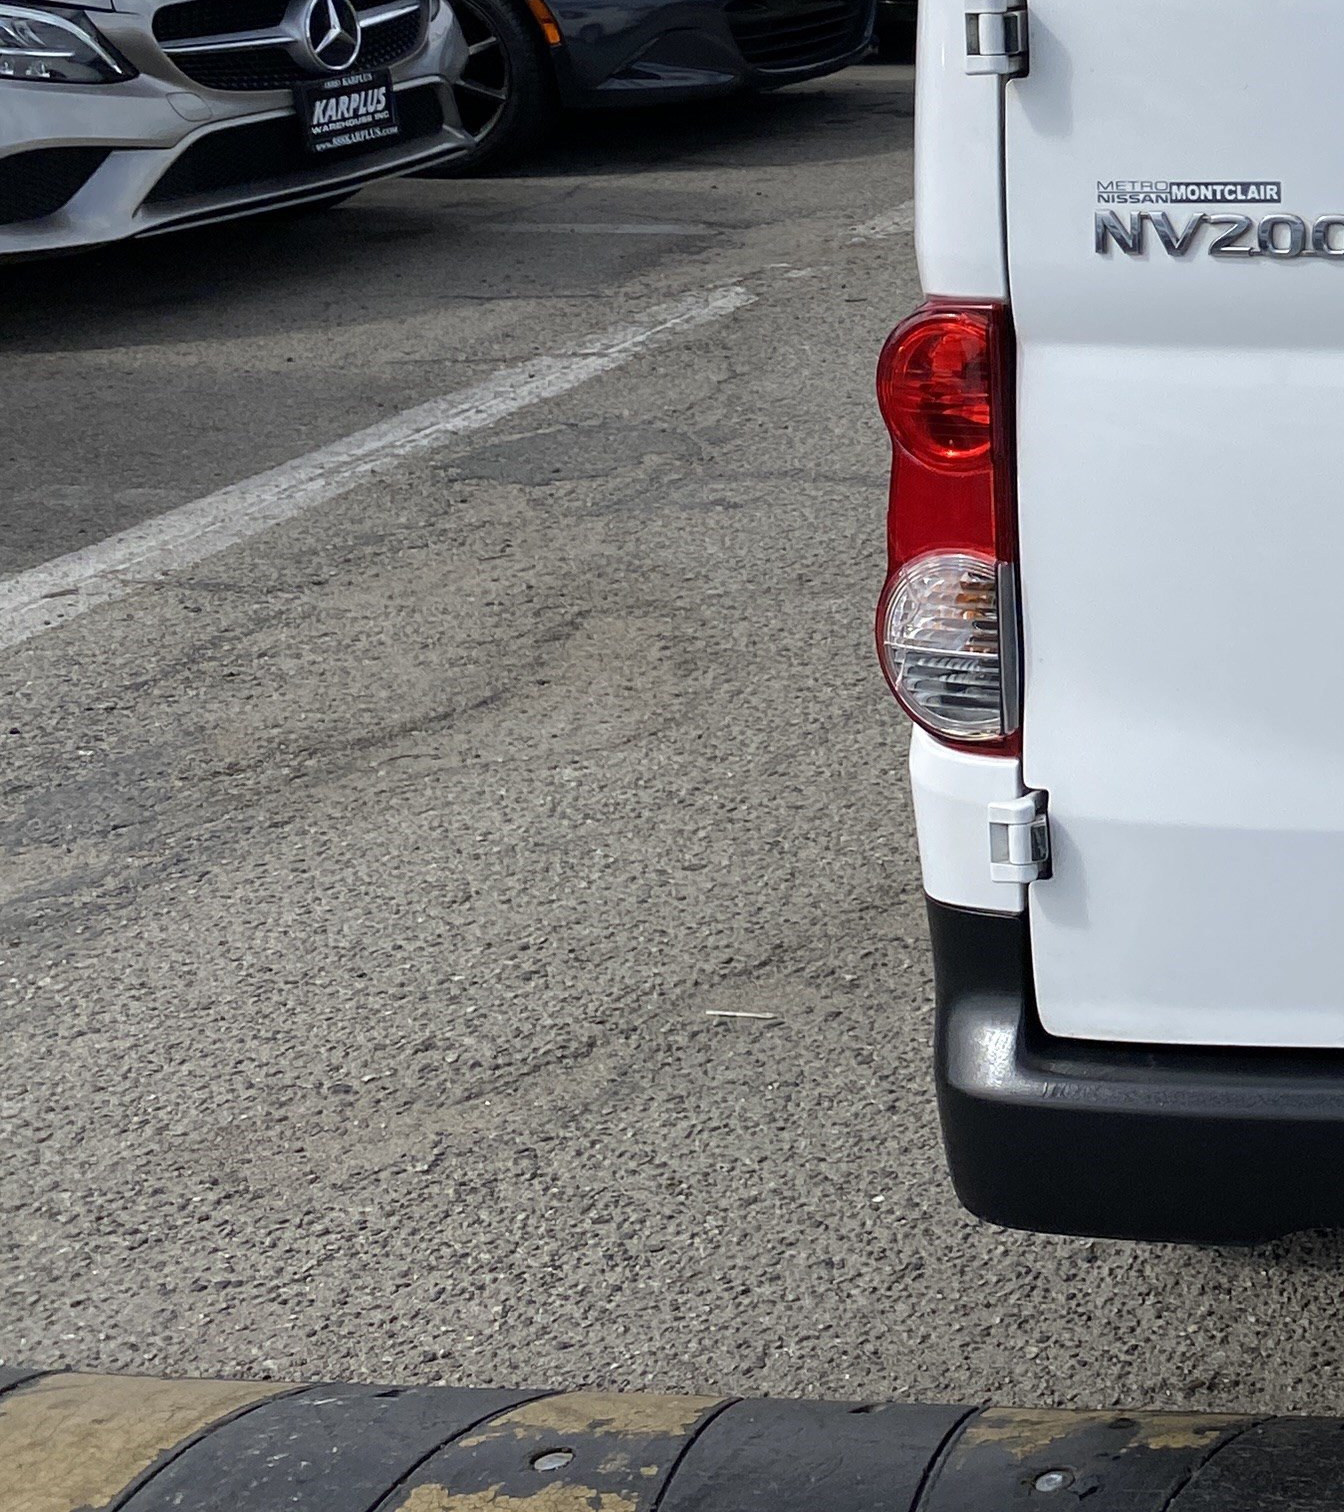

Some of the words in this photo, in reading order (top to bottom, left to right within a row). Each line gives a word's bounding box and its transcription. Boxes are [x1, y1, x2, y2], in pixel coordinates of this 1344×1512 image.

[312, 86, 387, 125] KARPLUS
[311, 114, 373, 135] WAREHOUSE
[374, 110, 390, 120] INC
[1097, 180, 1168, 191] METRO
[1170, 184, 1279, 201] MONTCLAIR
[1097, 193, 1169, 204] NISSAN
